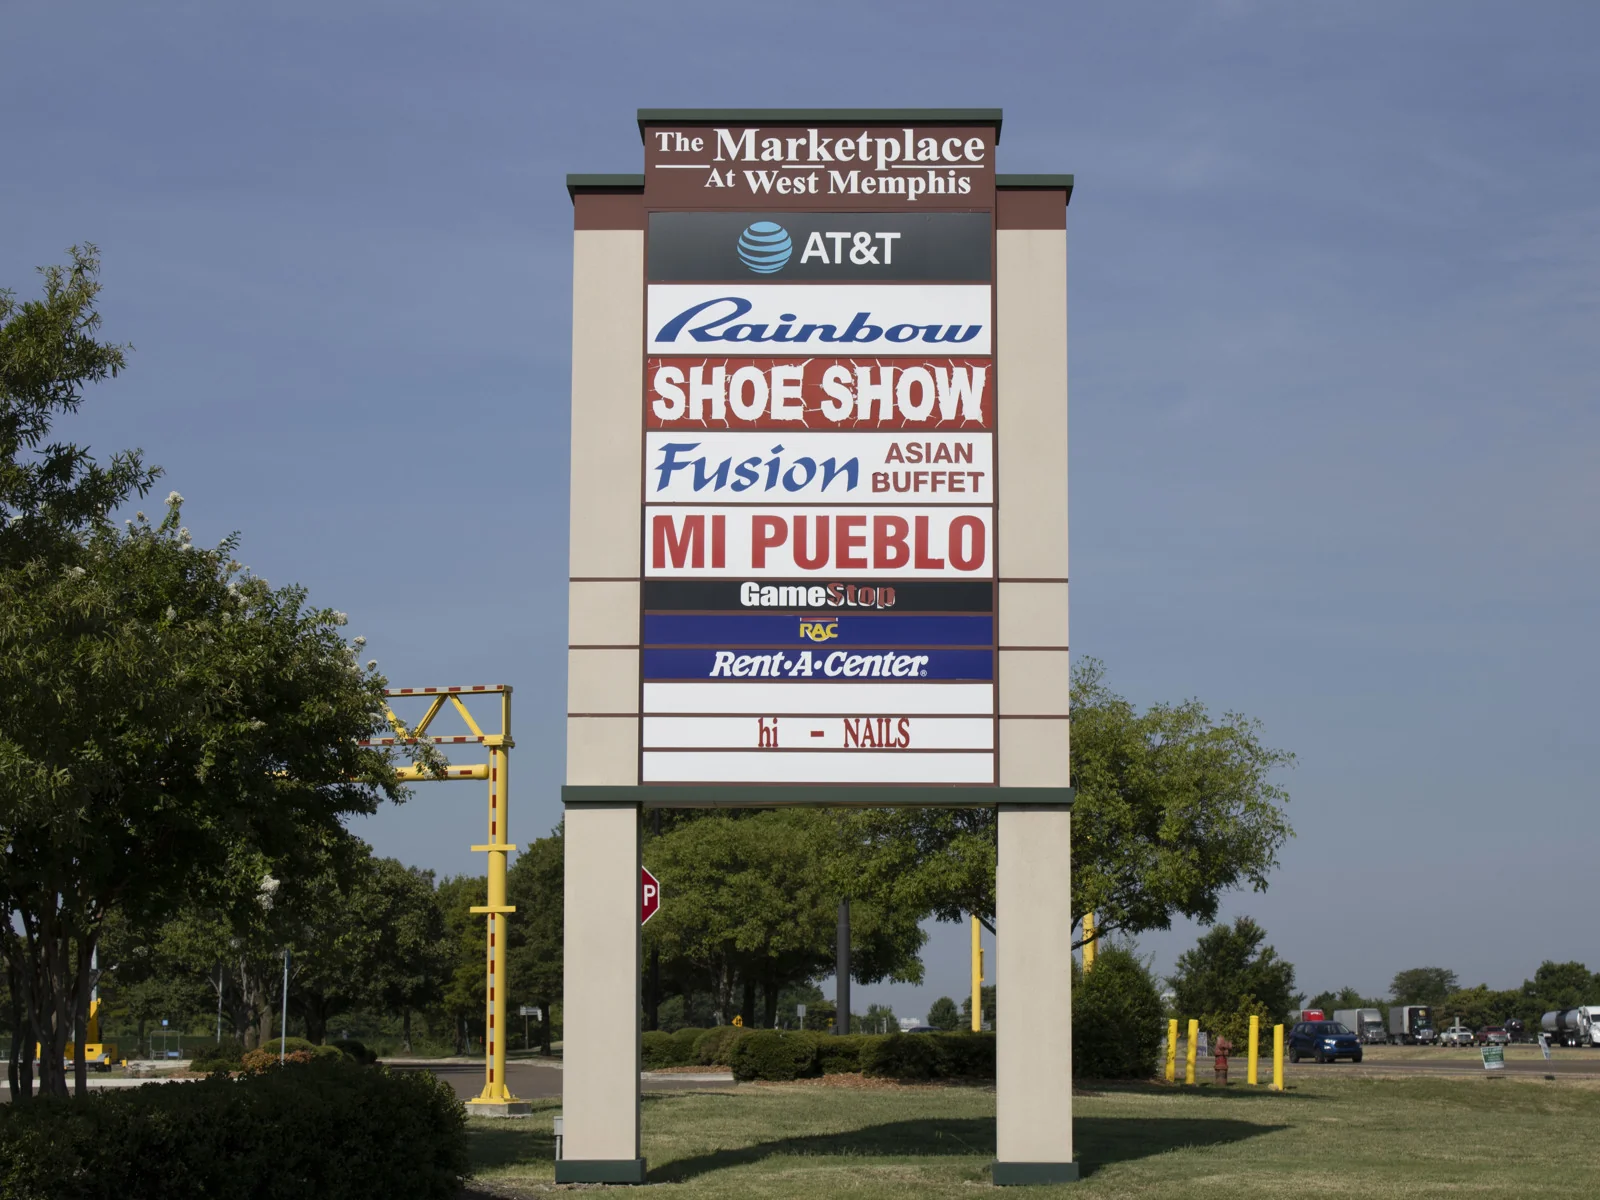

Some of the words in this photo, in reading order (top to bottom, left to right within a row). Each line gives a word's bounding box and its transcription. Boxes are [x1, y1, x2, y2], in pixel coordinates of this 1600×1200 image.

[655, 132, 704, 151] The
[713, 128, 985, 170] Marketplace
[704, 168, 736, 187] At
[743, 170, 819, 195] West
[828, 170, 971, 200] Memphis
[800, 231, 901, 264] AT&T
[654, 296, 983, 343] Rainbow
[652, 365, 804, 421] SHOE
[820, 365, 987, 422] SHOW
[654, 442, 859, 493] Fusion
[884, 442, 973, 464] ASIAN
[871, 471, 985, 493] BUFFET
[652, 515, 726, 569] MI
[751, 515, 986, 571] PUEBLO
[740, 581, 896, 609] GameStop
[799, 623, 839, 642] RAC
[757, 717, 779, 748] hi
[810, 730, 825, 738] -
[843, 718, 910, 748] NAILS
